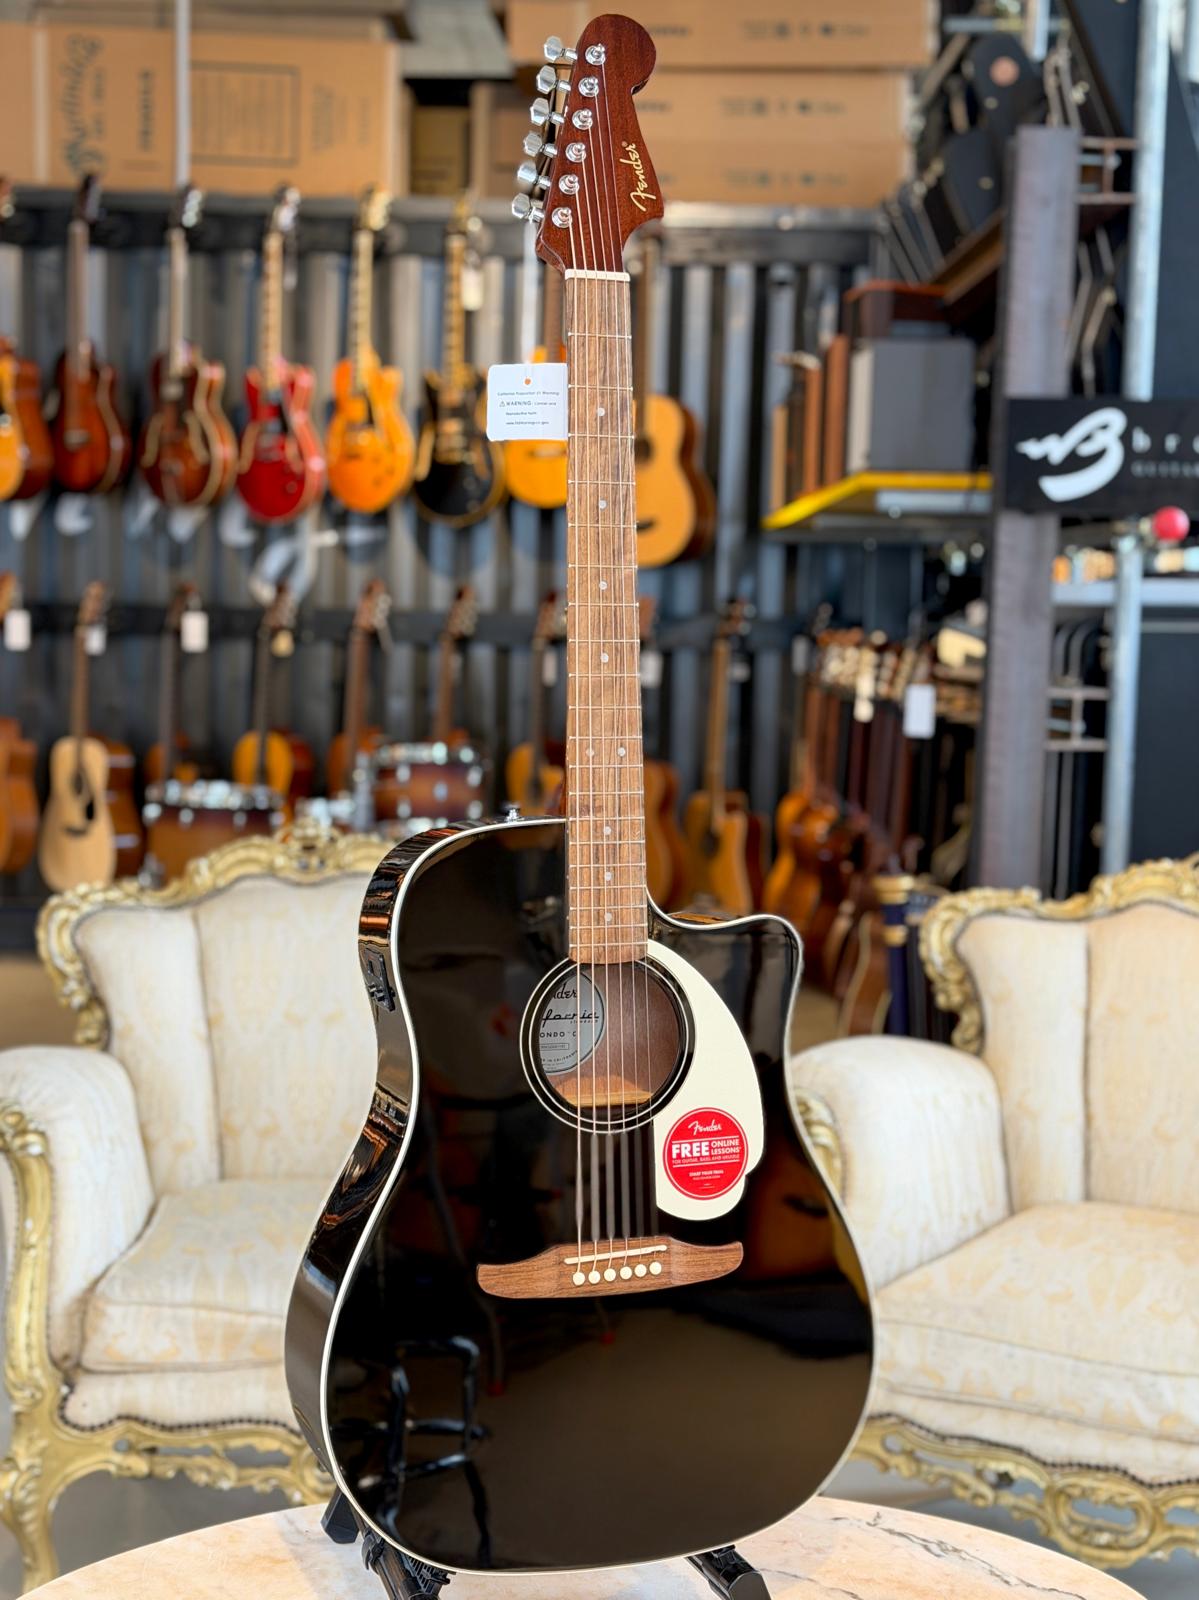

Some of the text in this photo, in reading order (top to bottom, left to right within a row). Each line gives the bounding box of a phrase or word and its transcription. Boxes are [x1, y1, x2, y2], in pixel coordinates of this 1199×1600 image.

[619, 143, 657, 212] Fender
[539, 1031, 565, 1039] ONDO
[688, 1119, 722, 1136] Fender
[671, 1139, 740, 1159] FREE ONLINE
[711, 1147, 740, 1156] LESSONS
